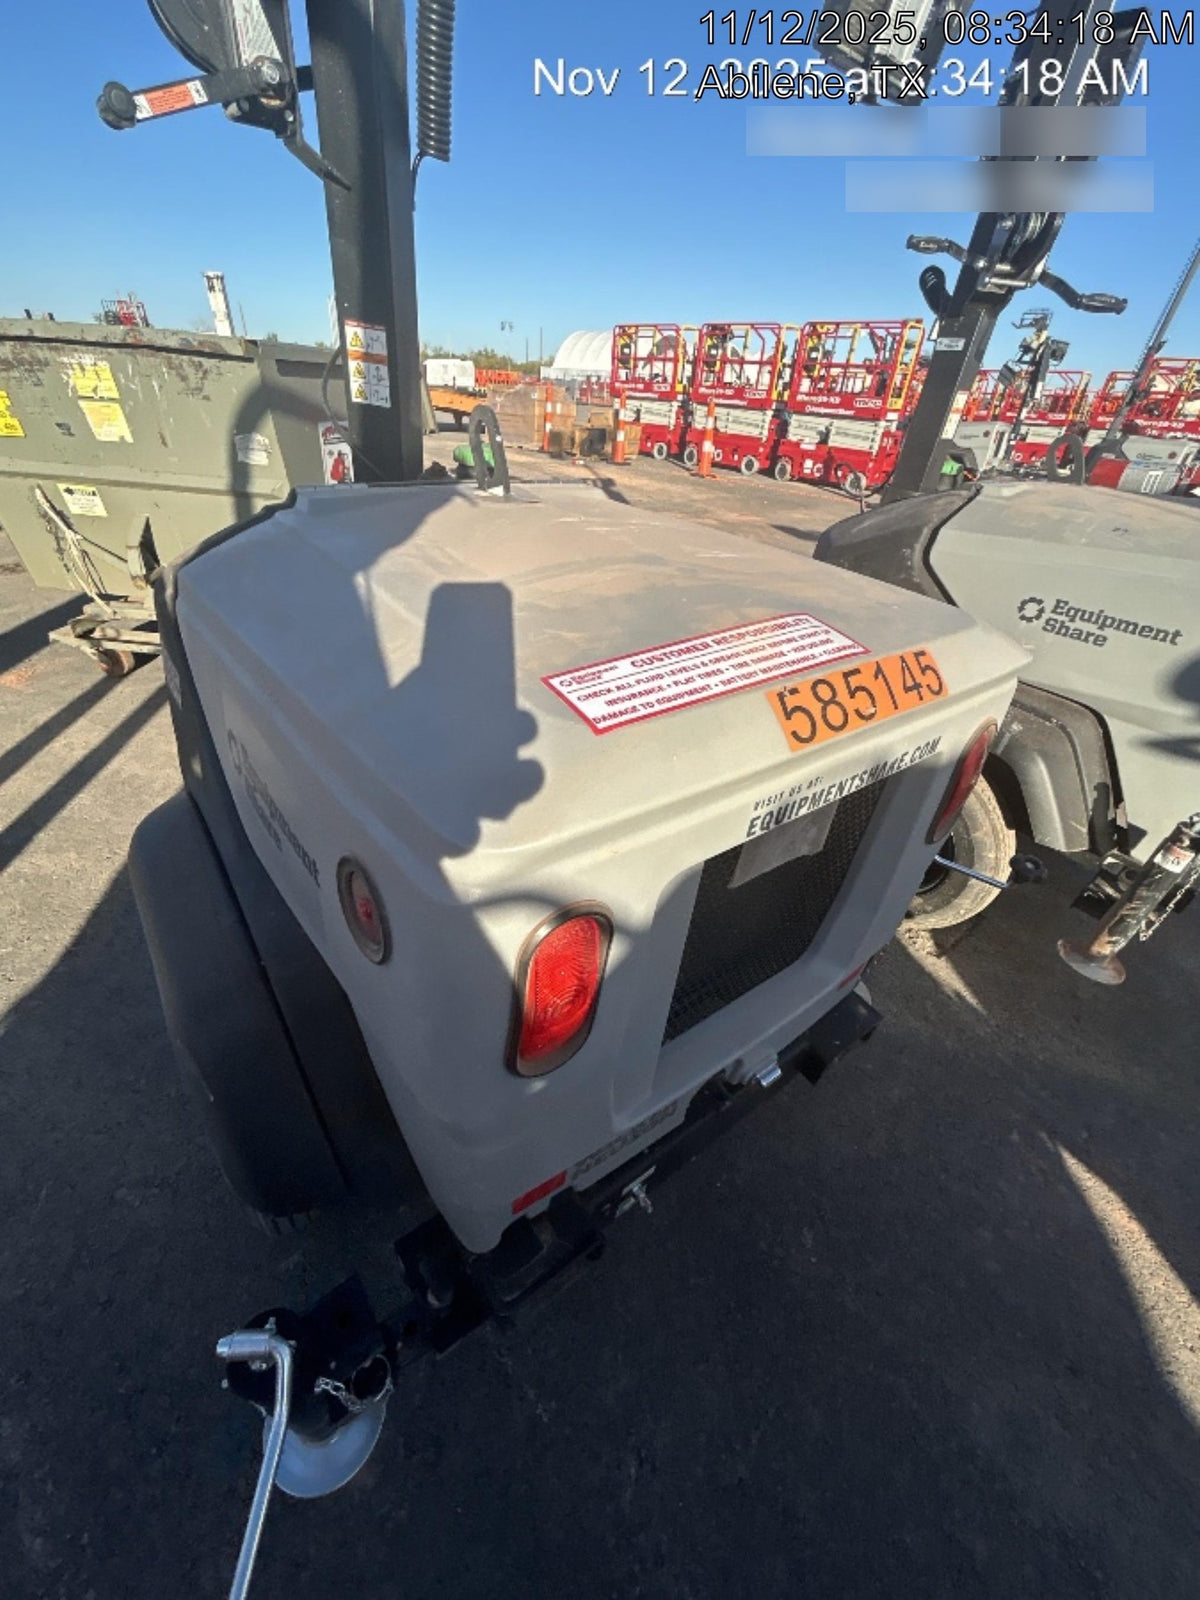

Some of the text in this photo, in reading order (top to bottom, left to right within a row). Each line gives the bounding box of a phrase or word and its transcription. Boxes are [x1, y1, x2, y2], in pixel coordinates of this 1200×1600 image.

[630, 617, 811, 668] CUSTOMER RESPONSIBILITY
[1042, 616, 1109, 647] Share
[1051, 599, 1183, 646] Equipment
[577, 688, 616, 701] CHECK
[615, 681, 635, 693] ALL
[635, 672, 665, 687] FLUID
[665, 663, 701, 678] LEVELS
[592, 705, 640, 725] DAMAGE
[640, 700, 656, 711] TO
[656, 683, 714, 705] EQUIPMENT
[719, 670, 759, 688] BATTERY
[604, 685, 668, 708] INSURANCE
[698, 668, 725, 680] TIRES
[730, 660, 751, 671] TIRE
[777, 650, 943, 744] 585145
[746, 736, 942, 838] EQUIPMENTSHARE.COM
[753, 776, 825, 811] VISIT US AT:
